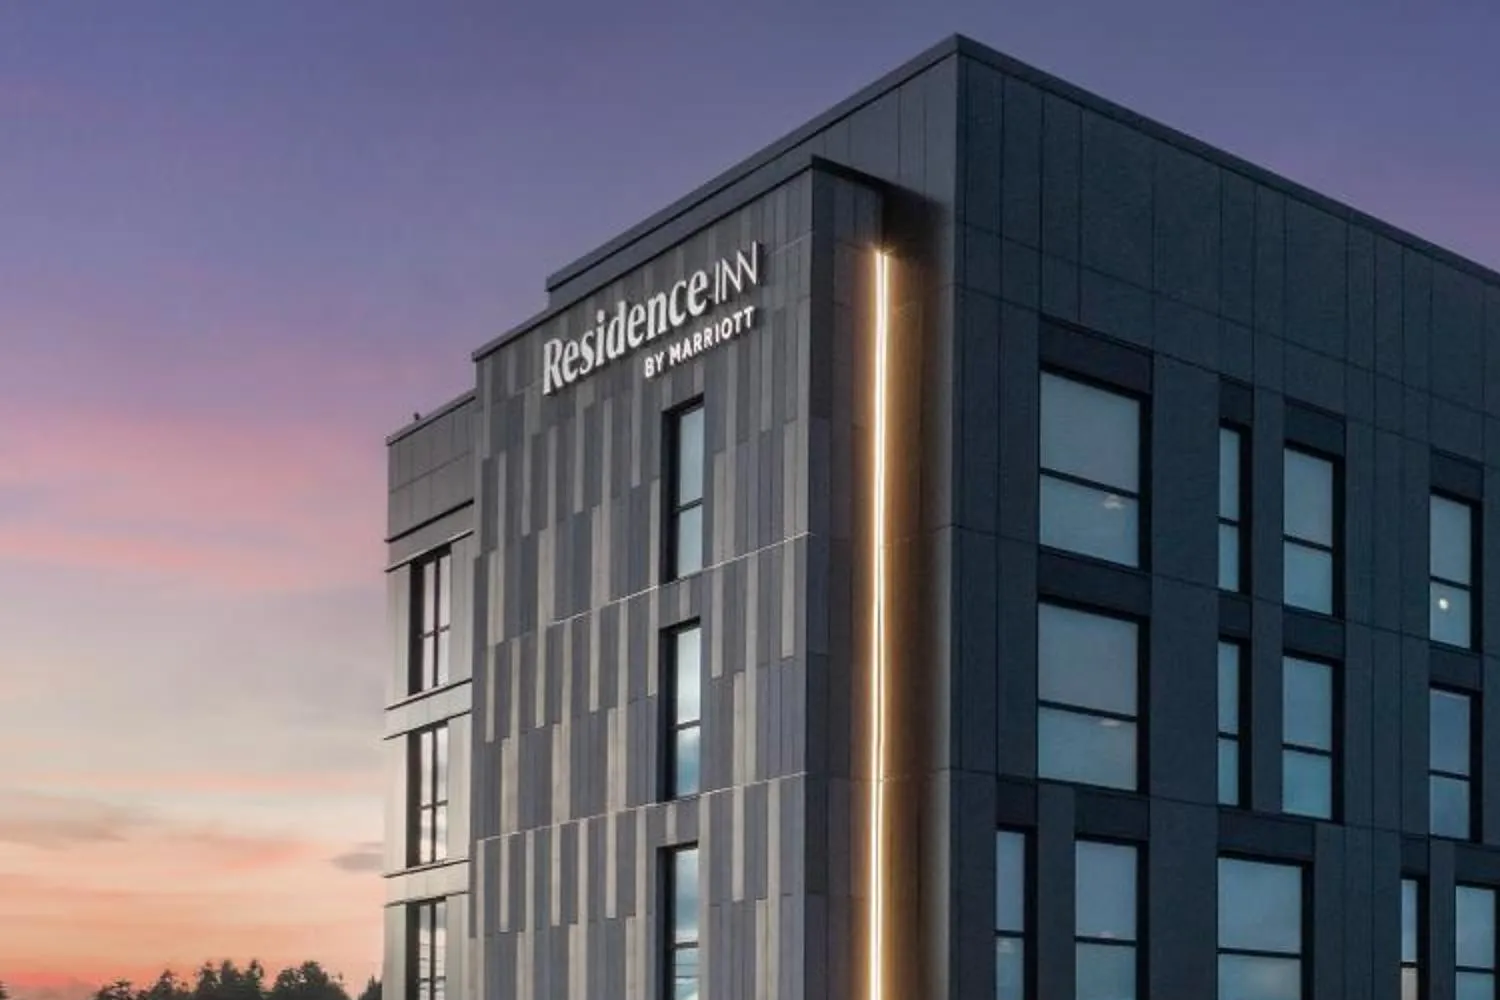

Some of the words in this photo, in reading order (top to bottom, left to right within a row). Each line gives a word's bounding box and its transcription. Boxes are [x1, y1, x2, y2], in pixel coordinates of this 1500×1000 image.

[543, 270, 709, 395] Residence
[715, 240, 759, 304] INN
[644, 351, 665, 378] BY
[669, 305, 755, 366] MARRIOTT
